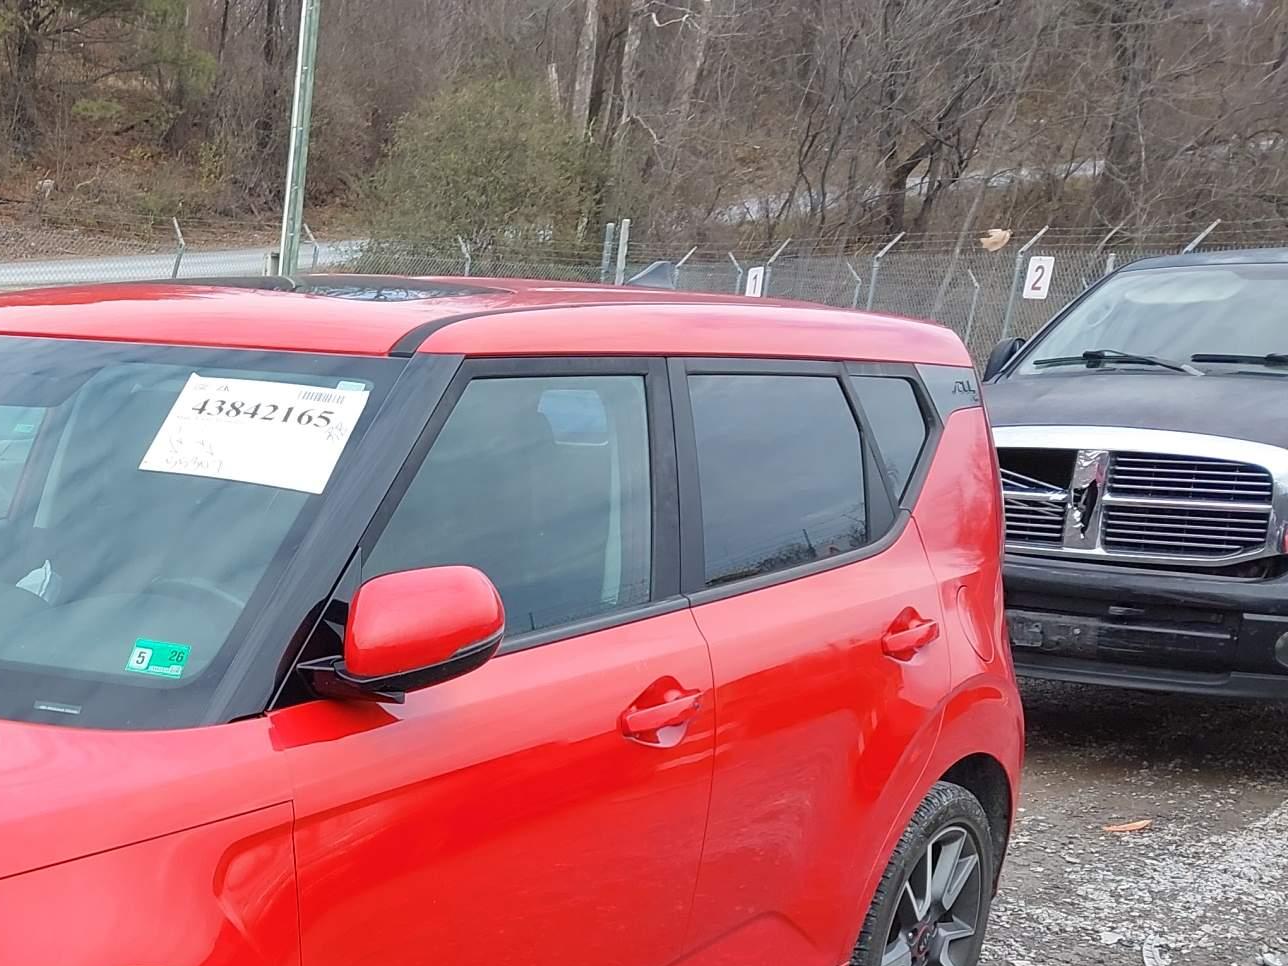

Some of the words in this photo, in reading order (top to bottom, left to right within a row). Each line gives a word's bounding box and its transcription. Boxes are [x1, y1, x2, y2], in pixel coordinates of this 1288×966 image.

[752, 272, 759, 295] 1
[1031, 264, 1045, 291] 2
[192, 398, 335, 428] 43842165
[135, 651, 147, 665] 5
[169, 650, 185, 664] 26
